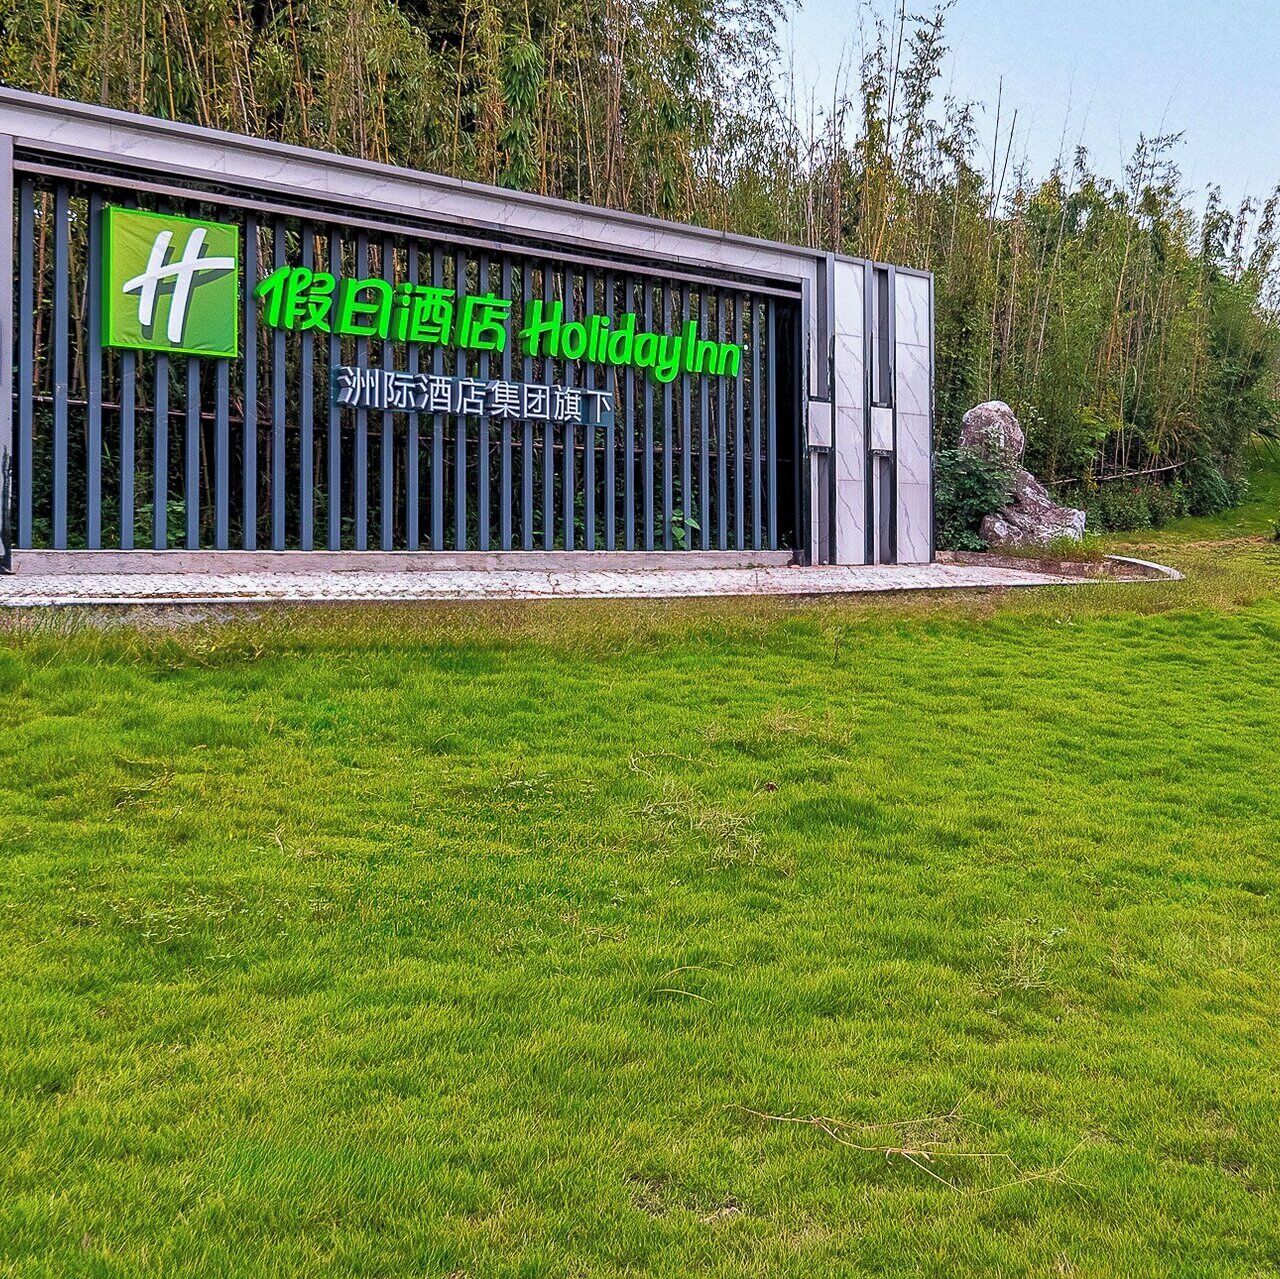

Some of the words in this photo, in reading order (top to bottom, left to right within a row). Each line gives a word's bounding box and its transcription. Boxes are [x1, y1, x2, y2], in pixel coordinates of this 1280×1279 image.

[254, 265, 513, 353] 假日酒店
[337, 366, 614, 423] 洲际酒店集团旗下
